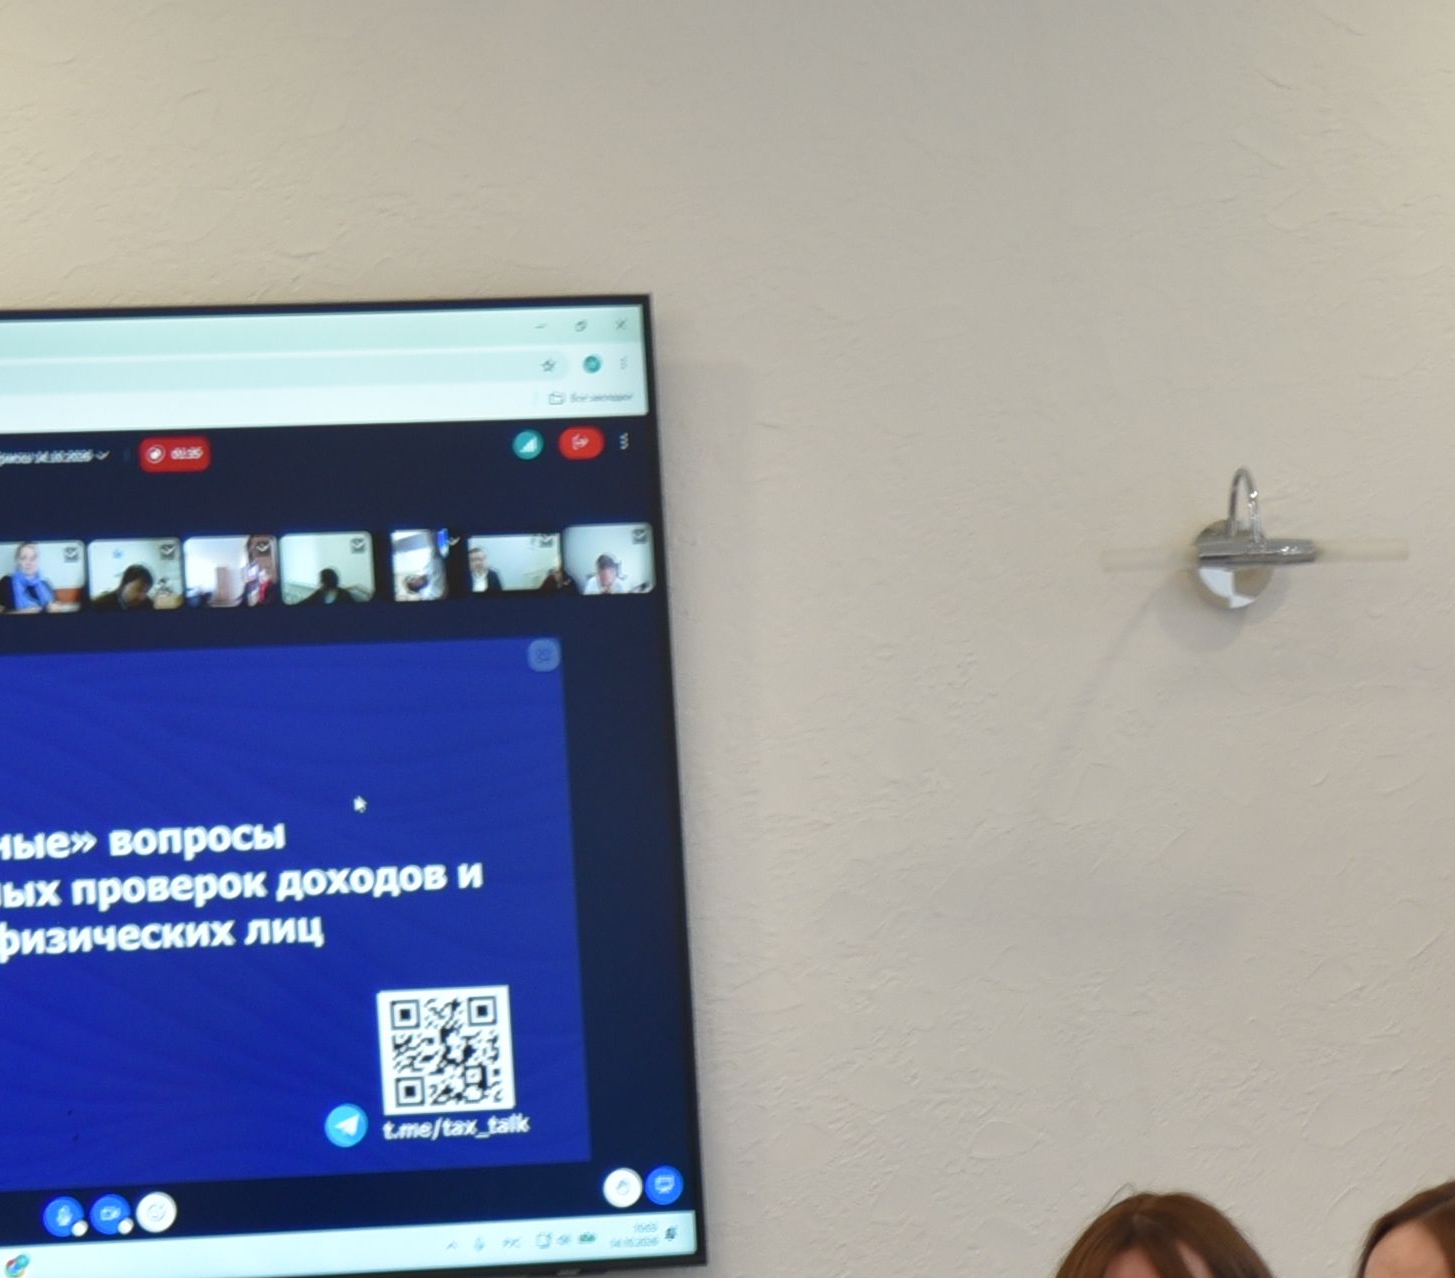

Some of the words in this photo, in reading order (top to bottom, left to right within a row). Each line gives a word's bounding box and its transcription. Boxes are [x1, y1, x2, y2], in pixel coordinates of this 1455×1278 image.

[107, 821, 288, 870] вопросы
[70, 868, 269, 916] проверок
[274, 859, 450, 905] доходов
[456, 861, 485, 891] и
[242, 914, 327, 954] лиц
[381, 1112, 532, 1143] t.me/tax_talk
